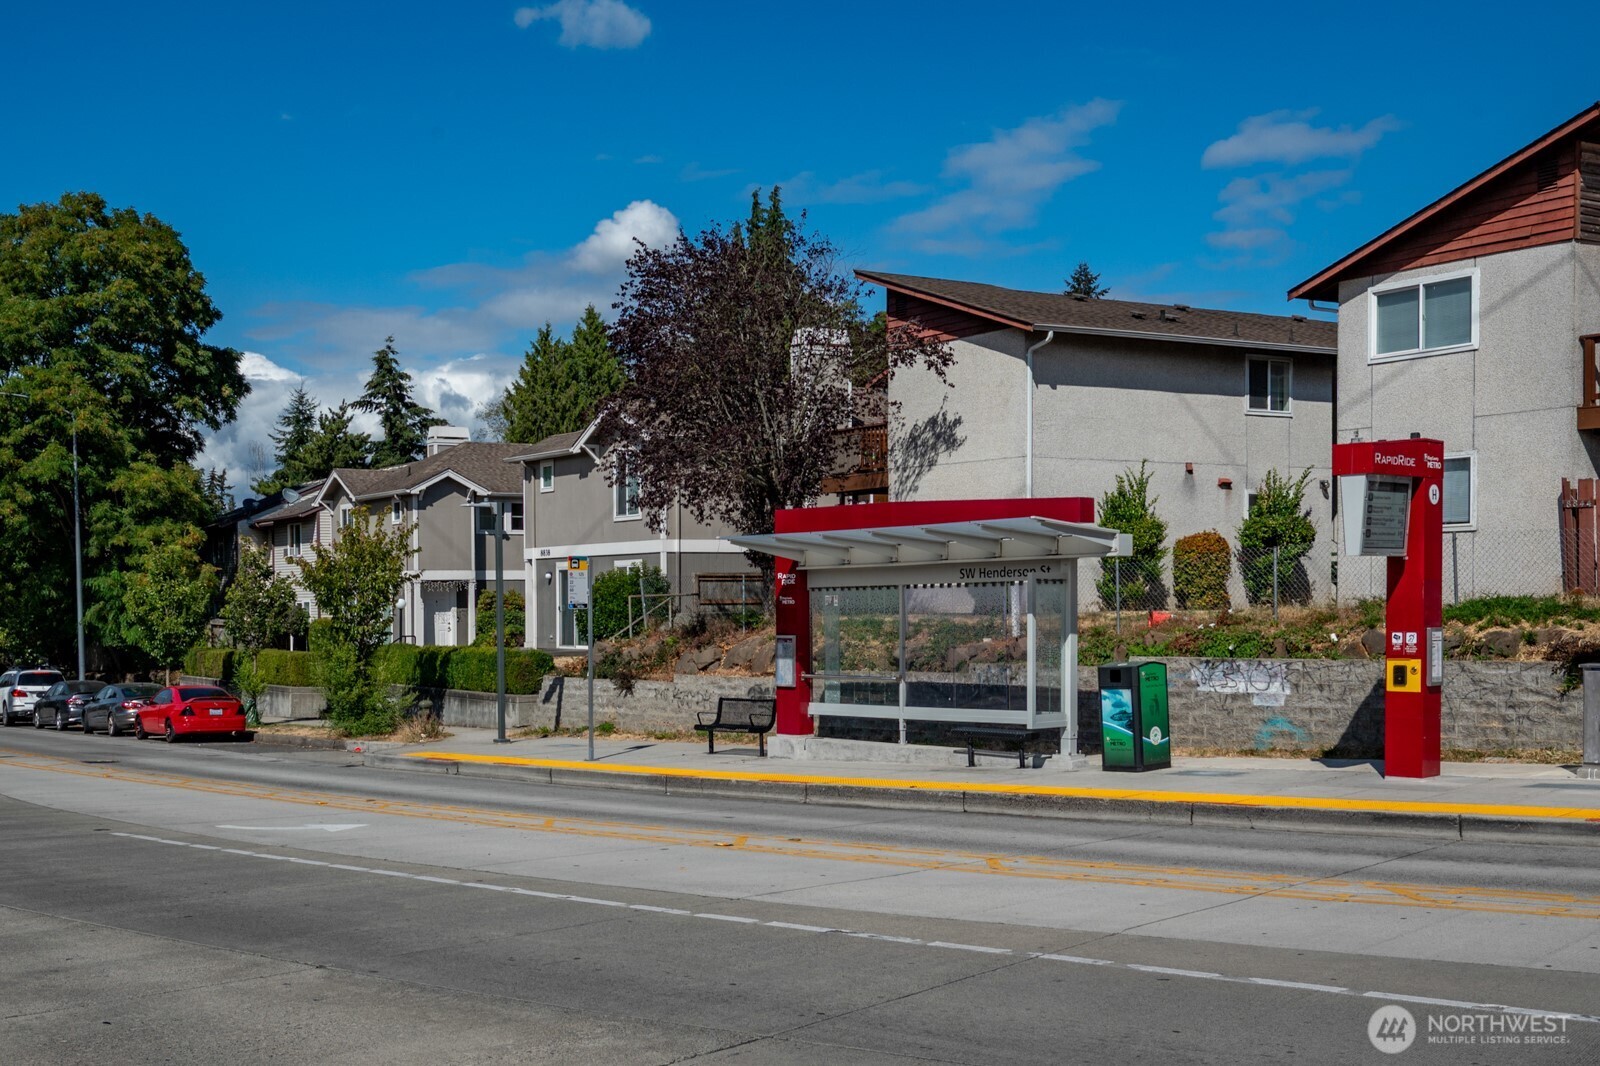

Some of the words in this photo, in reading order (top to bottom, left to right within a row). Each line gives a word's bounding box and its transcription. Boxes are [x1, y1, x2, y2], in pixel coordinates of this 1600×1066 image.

[1375, 452, 1416, 467] RAPIDRIDE
[1431, 489, 1437, 500] H
[960, 568, 976, 579] SW
